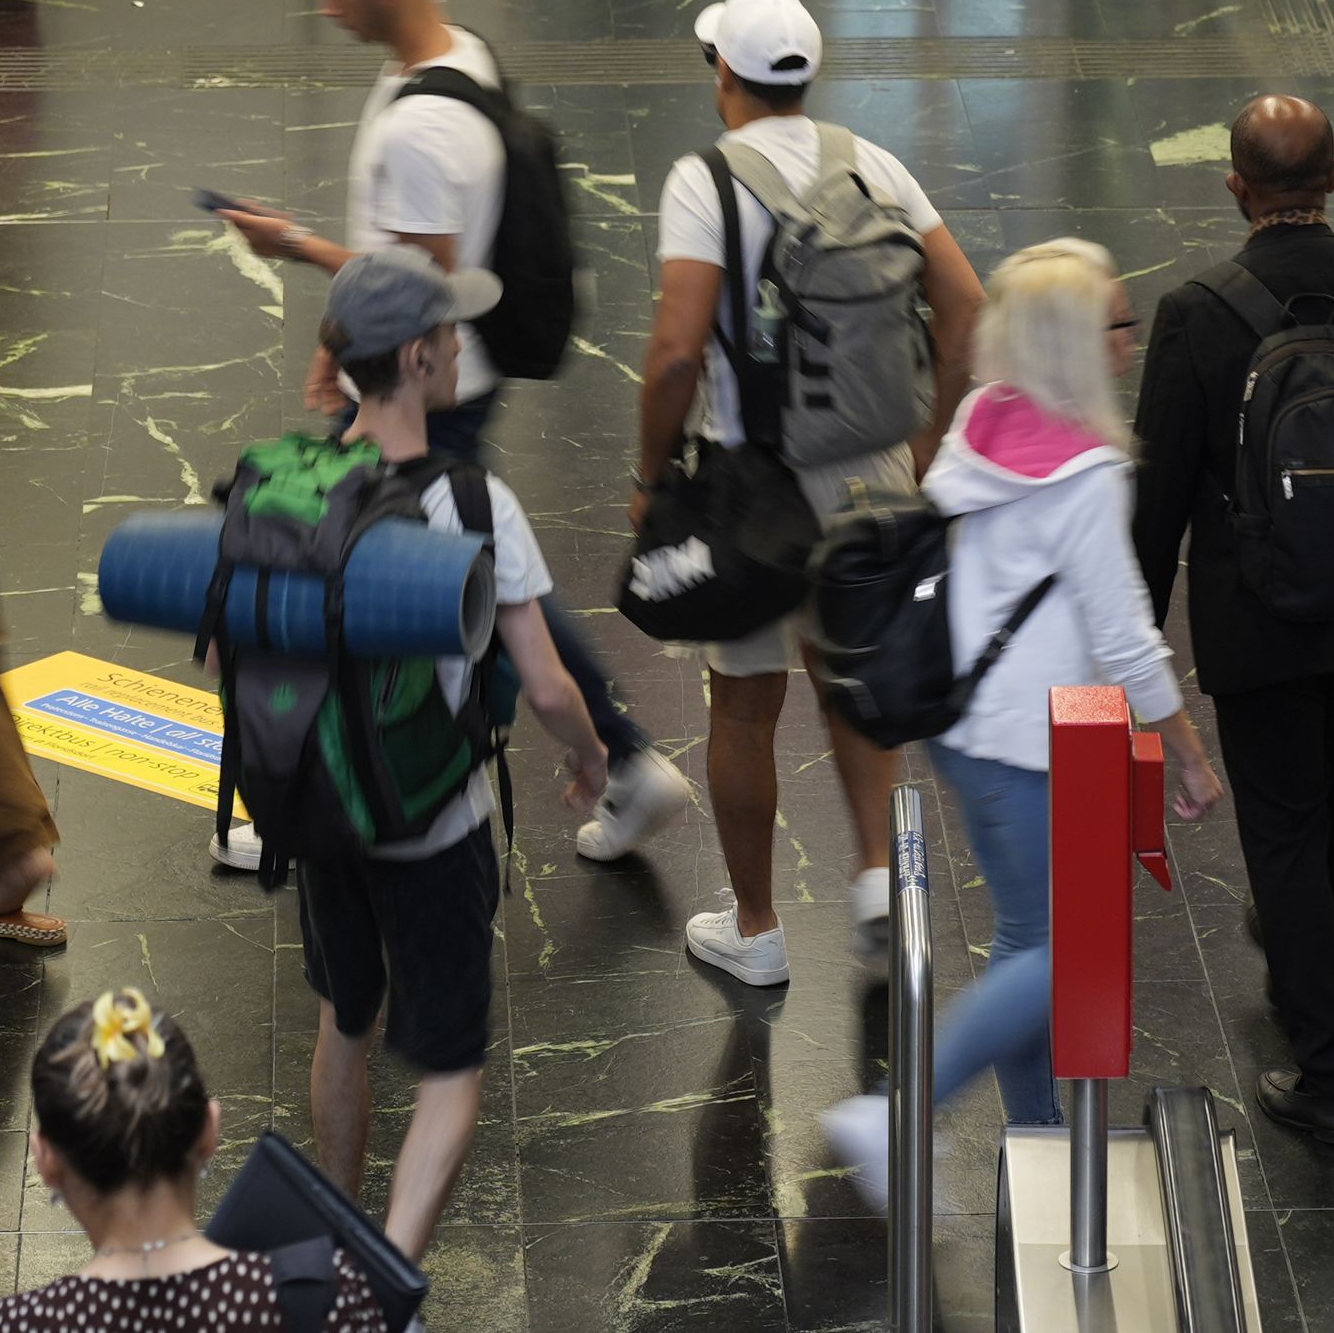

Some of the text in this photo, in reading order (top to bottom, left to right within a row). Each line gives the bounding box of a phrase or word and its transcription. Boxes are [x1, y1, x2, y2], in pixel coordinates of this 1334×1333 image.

[56, 694, 100, 712] Alle
[98, 706, 155, 729] Halte
[166, 730, 203, 742] all
[193, 738, 222, 755] sto
[105, 745, 201, 781] non-stop
